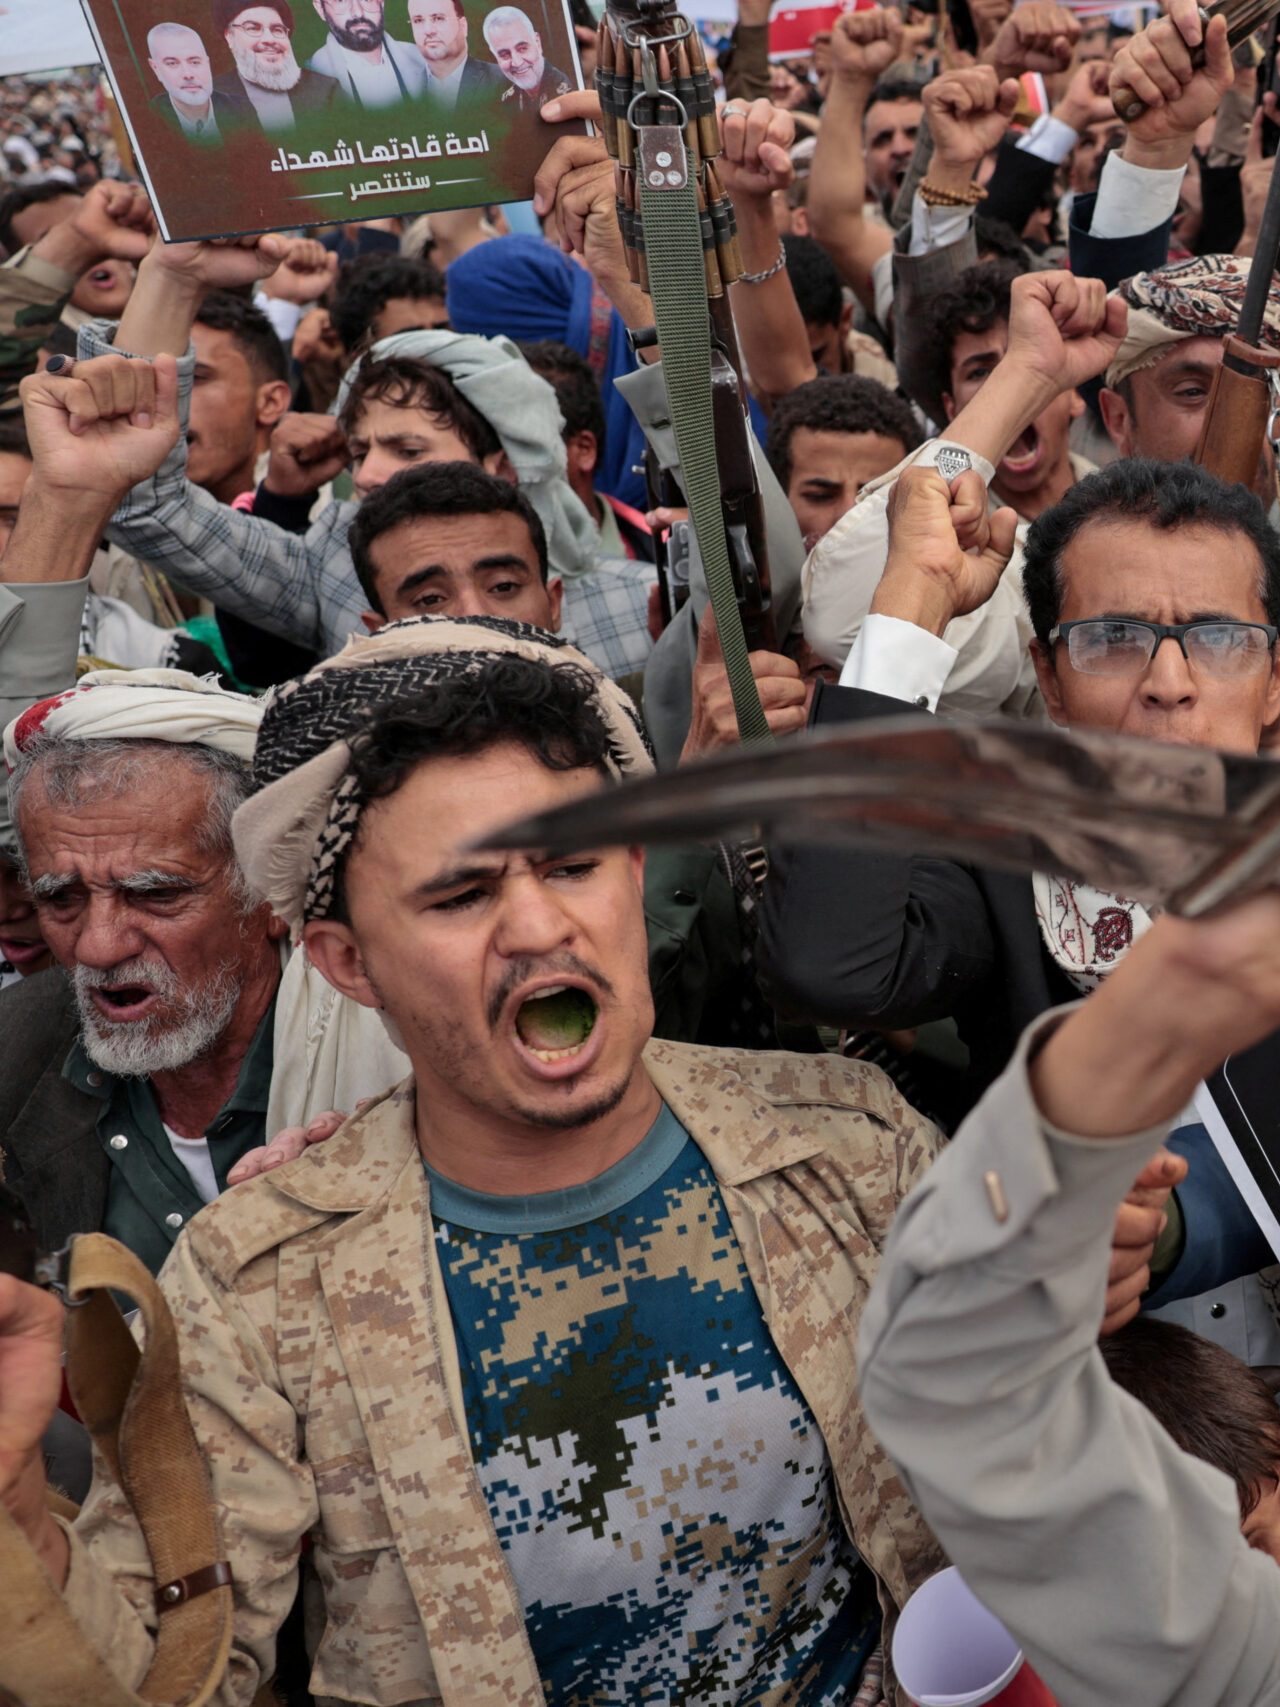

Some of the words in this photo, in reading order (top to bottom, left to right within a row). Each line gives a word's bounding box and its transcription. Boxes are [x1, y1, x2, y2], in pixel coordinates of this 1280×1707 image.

[270, 139, 355, 172] شهداء
[356, 134, 442, 163] قادتها
[445, 130, 490, 155] أمة
[350, 171, 431, 201] ستنتصر
